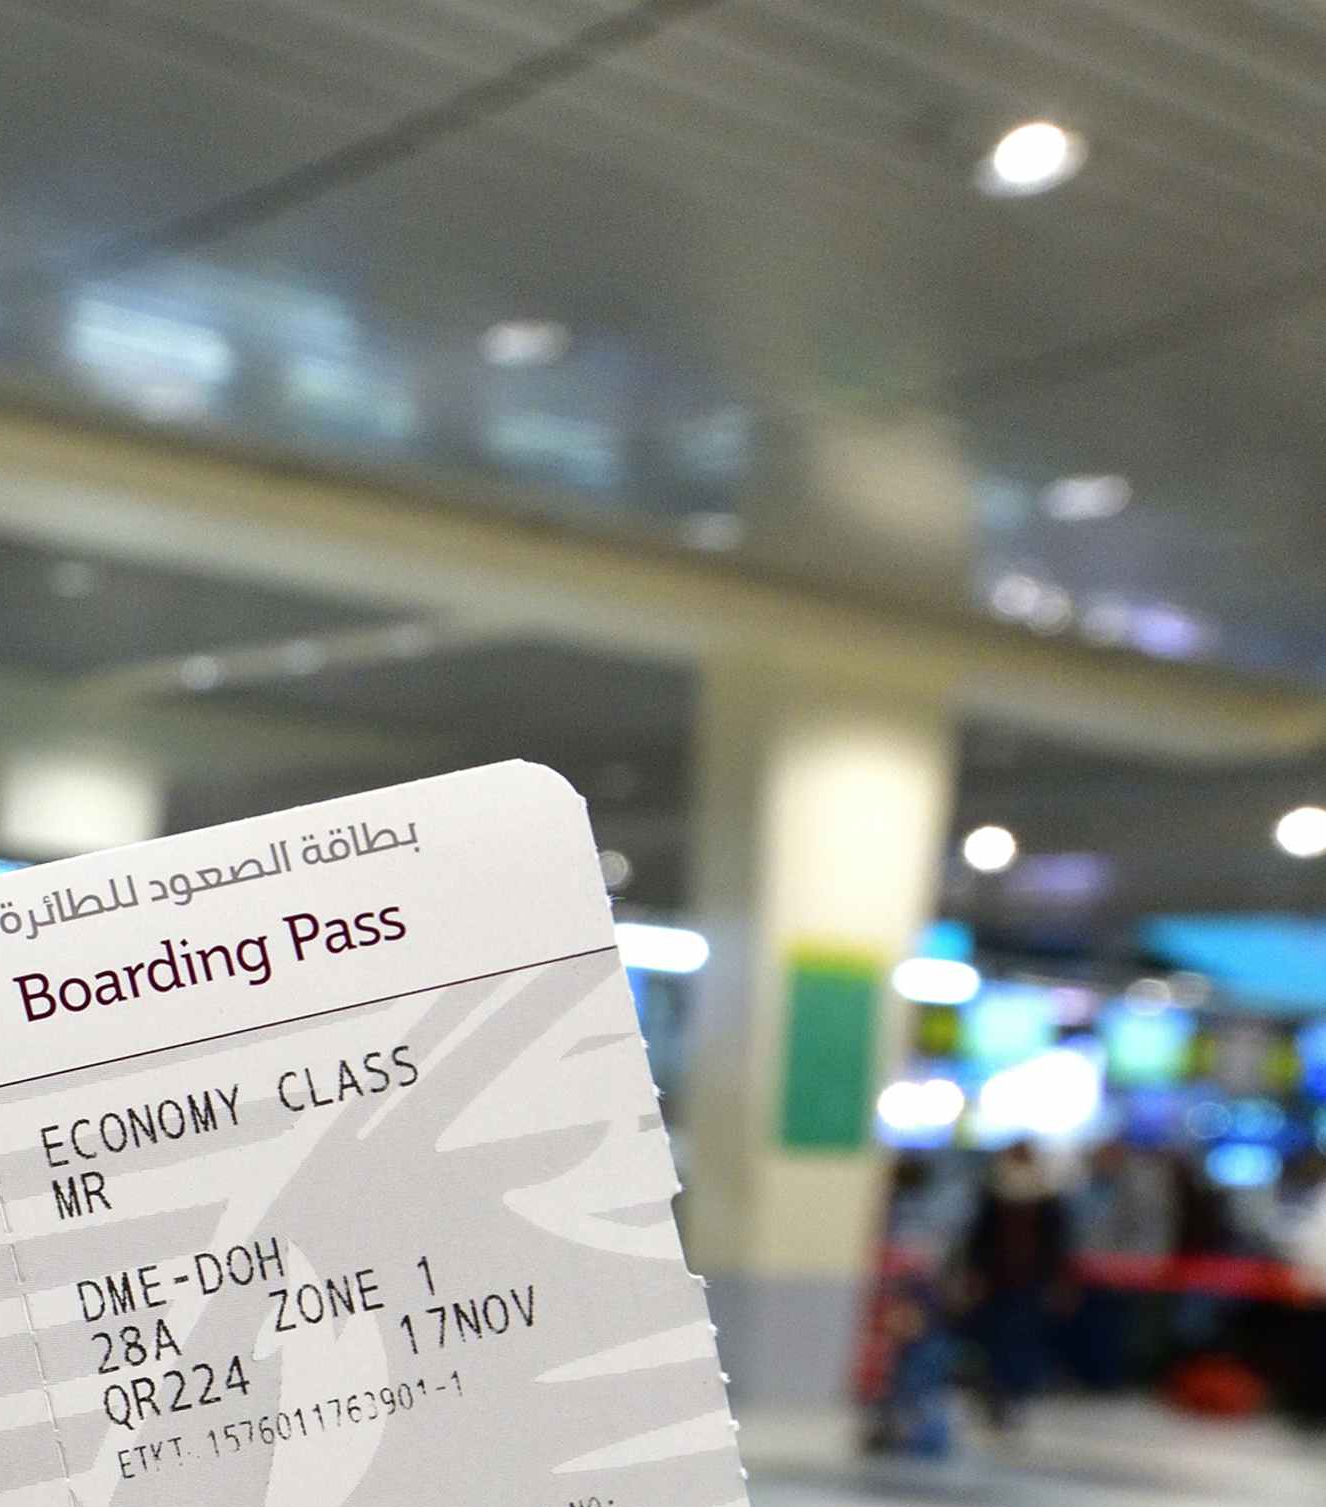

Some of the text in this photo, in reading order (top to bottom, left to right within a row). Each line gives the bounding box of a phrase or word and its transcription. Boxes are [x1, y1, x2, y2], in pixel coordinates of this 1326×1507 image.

[0, 821, 420, 940] بطاقة الصعود للطائرة
[13, 904, 407, 1023] Boarding Pass
[40, 1045, 420, 1169] ECONOMY CLASS
[51, 1169, 113, 1220] MR
[77, 1237, 286, 1323] DME-DOH
[91, 1256, 437, 1375] 28A ZONE 1
[102, 1285, 538, 1431] QR224 17NOV
